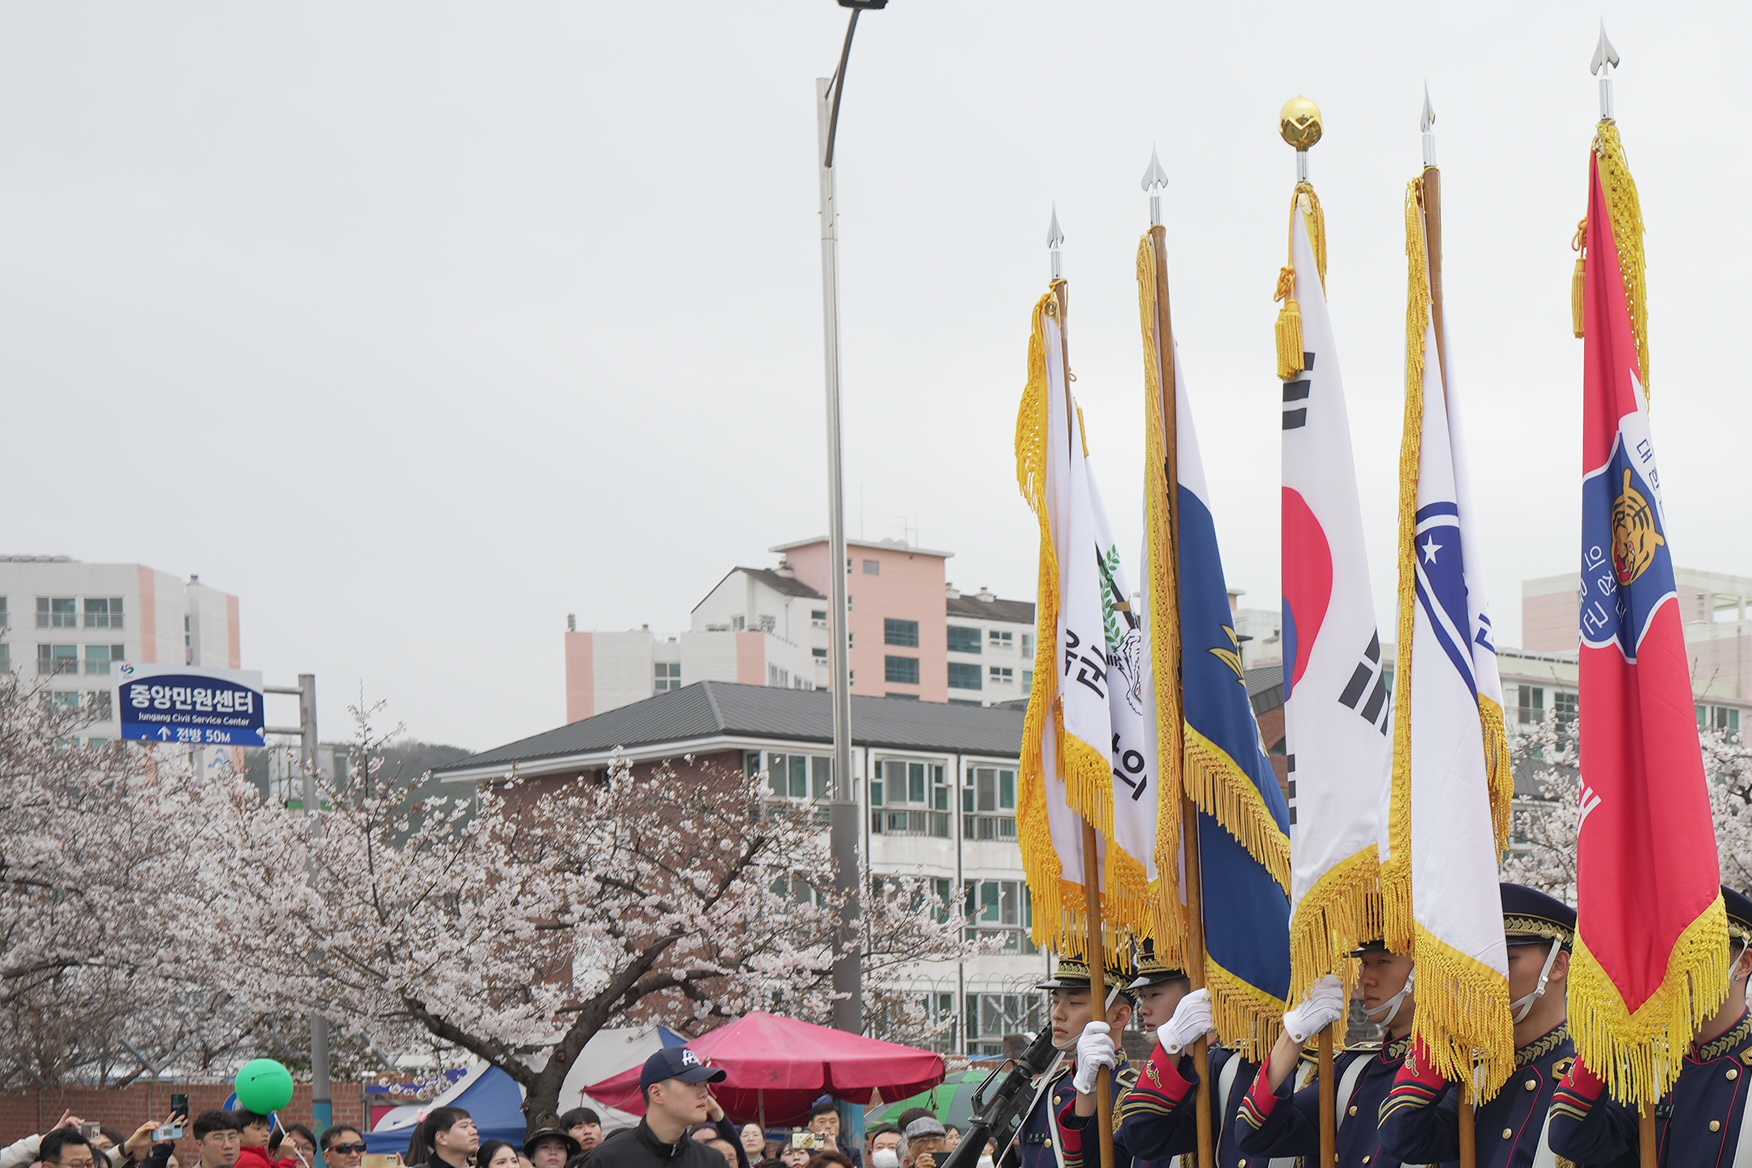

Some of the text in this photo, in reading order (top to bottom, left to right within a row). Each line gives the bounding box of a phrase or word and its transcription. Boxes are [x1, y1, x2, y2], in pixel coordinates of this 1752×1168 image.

[130, 684, 253, 714] 중앙민원센터
[138, 712, 250, 726] Jungang Civil Service Center
[176, 727, 202, 742] 전방
